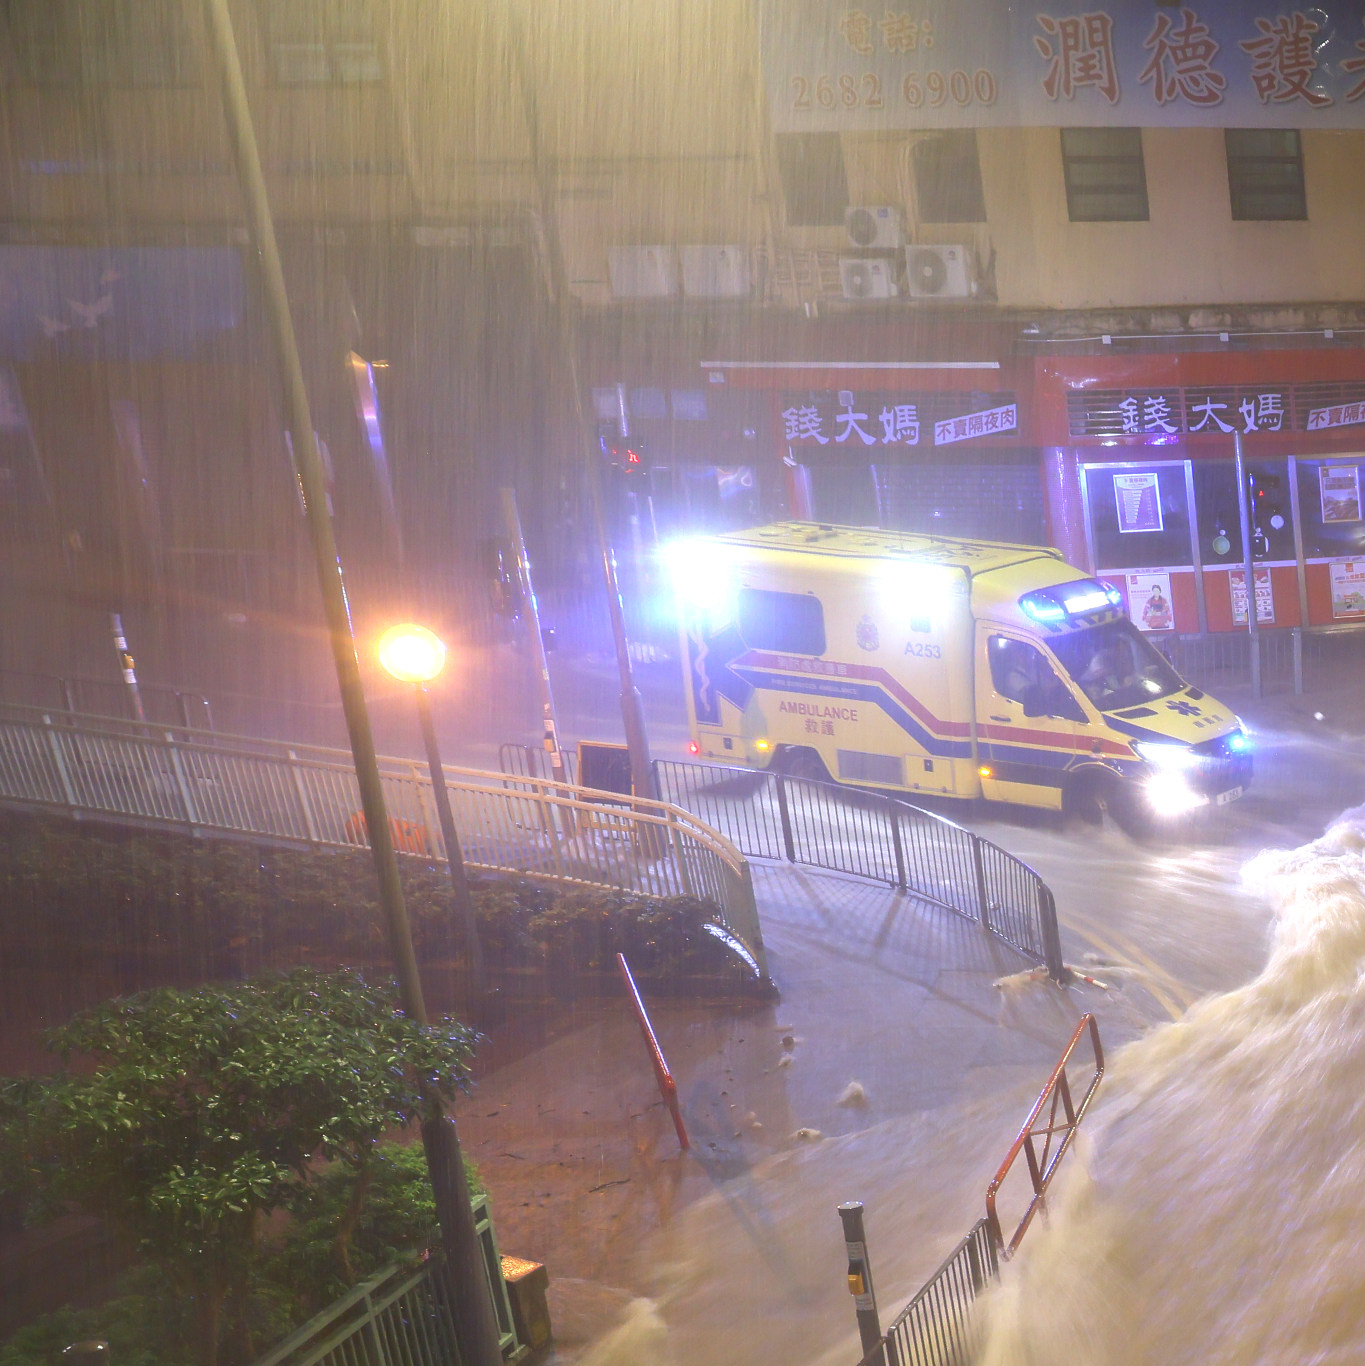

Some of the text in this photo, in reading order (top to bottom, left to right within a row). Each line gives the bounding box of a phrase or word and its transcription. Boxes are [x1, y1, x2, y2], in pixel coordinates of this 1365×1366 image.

[791, 70, 996, 108] 2682 6900
[781, 404, 920, 446] 錢大媽
[936, 409, 1015, 441] 不賣隔夜肉
[1118, 394, 1285, 434] 錢大媽
[904, 641, 942, 659] A253
[779, 700, 859, 721] AMBULANCE
[804, 718, 835, 736] 救護
